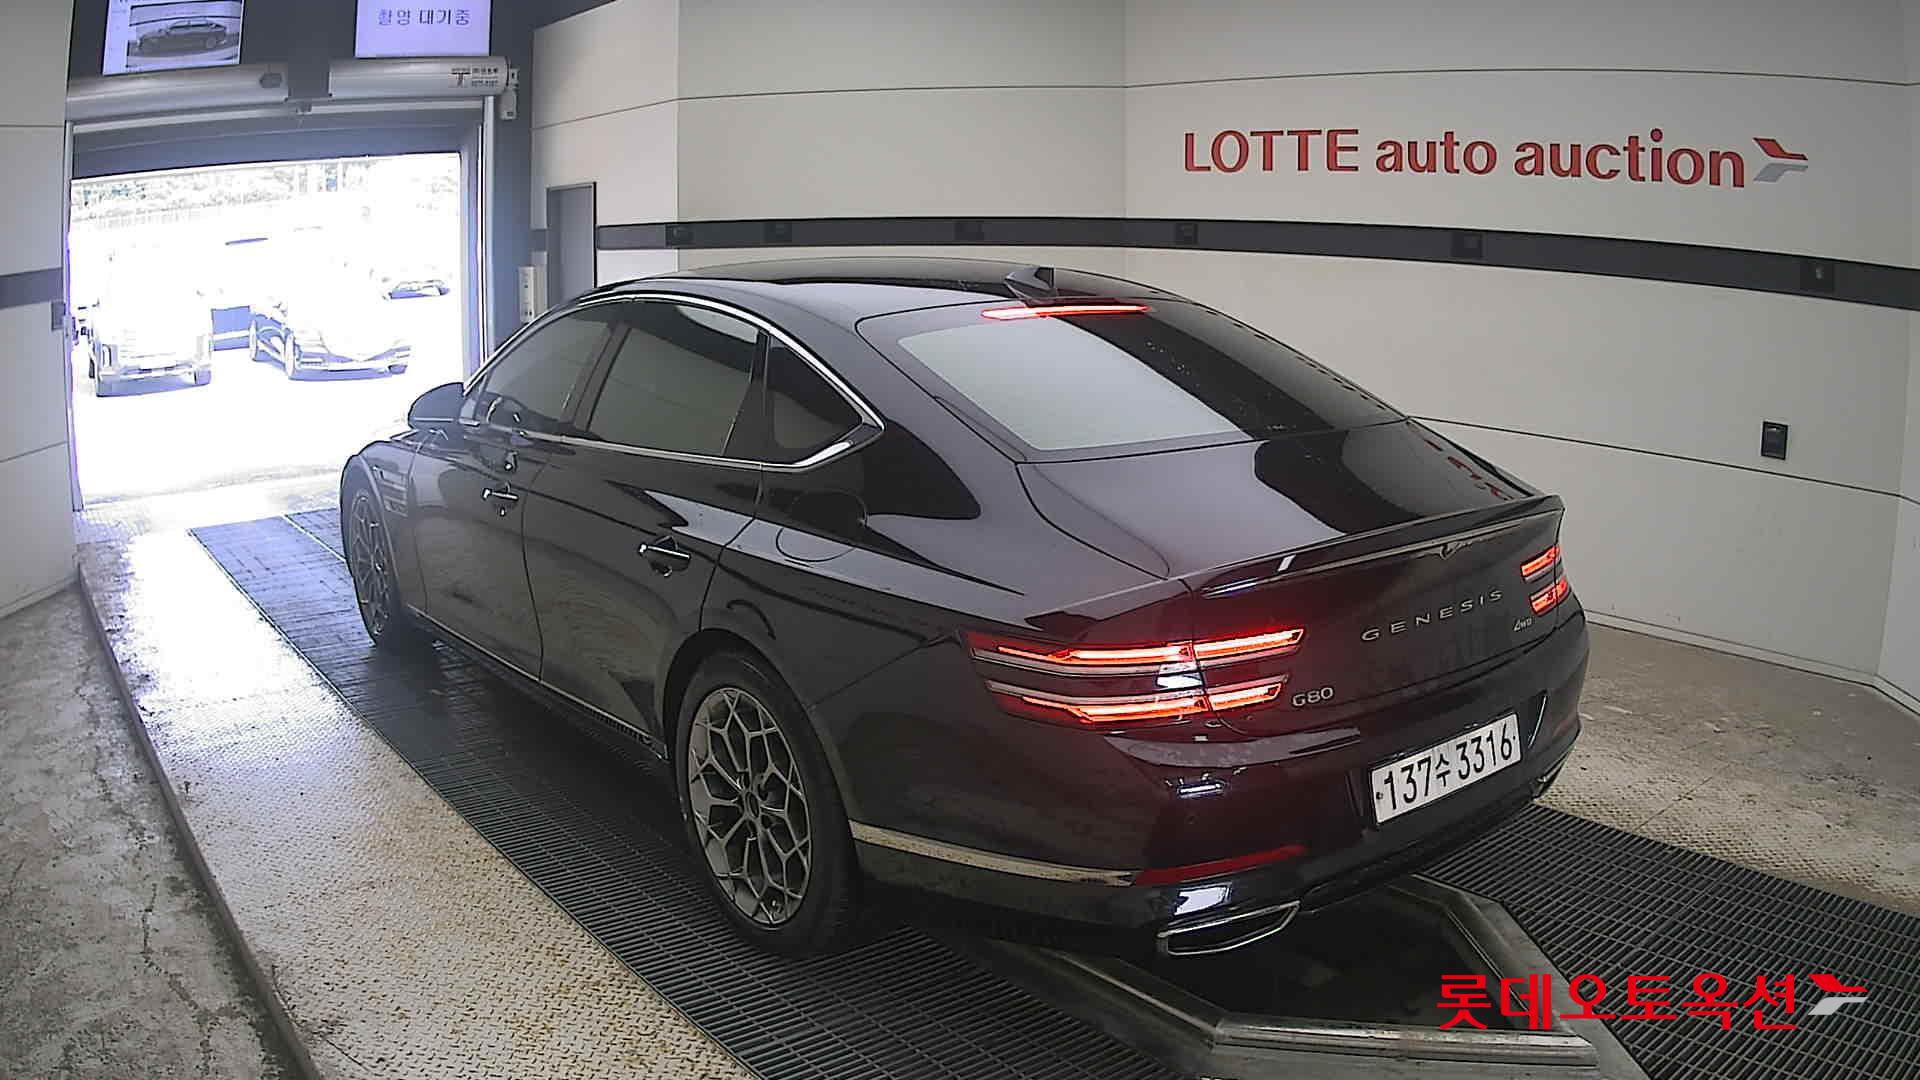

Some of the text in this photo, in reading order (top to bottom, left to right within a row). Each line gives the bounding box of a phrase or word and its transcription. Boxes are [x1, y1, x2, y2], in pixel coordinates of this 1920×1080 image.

[1184, 128, 1745, 189] LOTTE auto auction
[1361, 590, 1503, 642] GENESIS
[1292, 687, 1334, 707] G80
